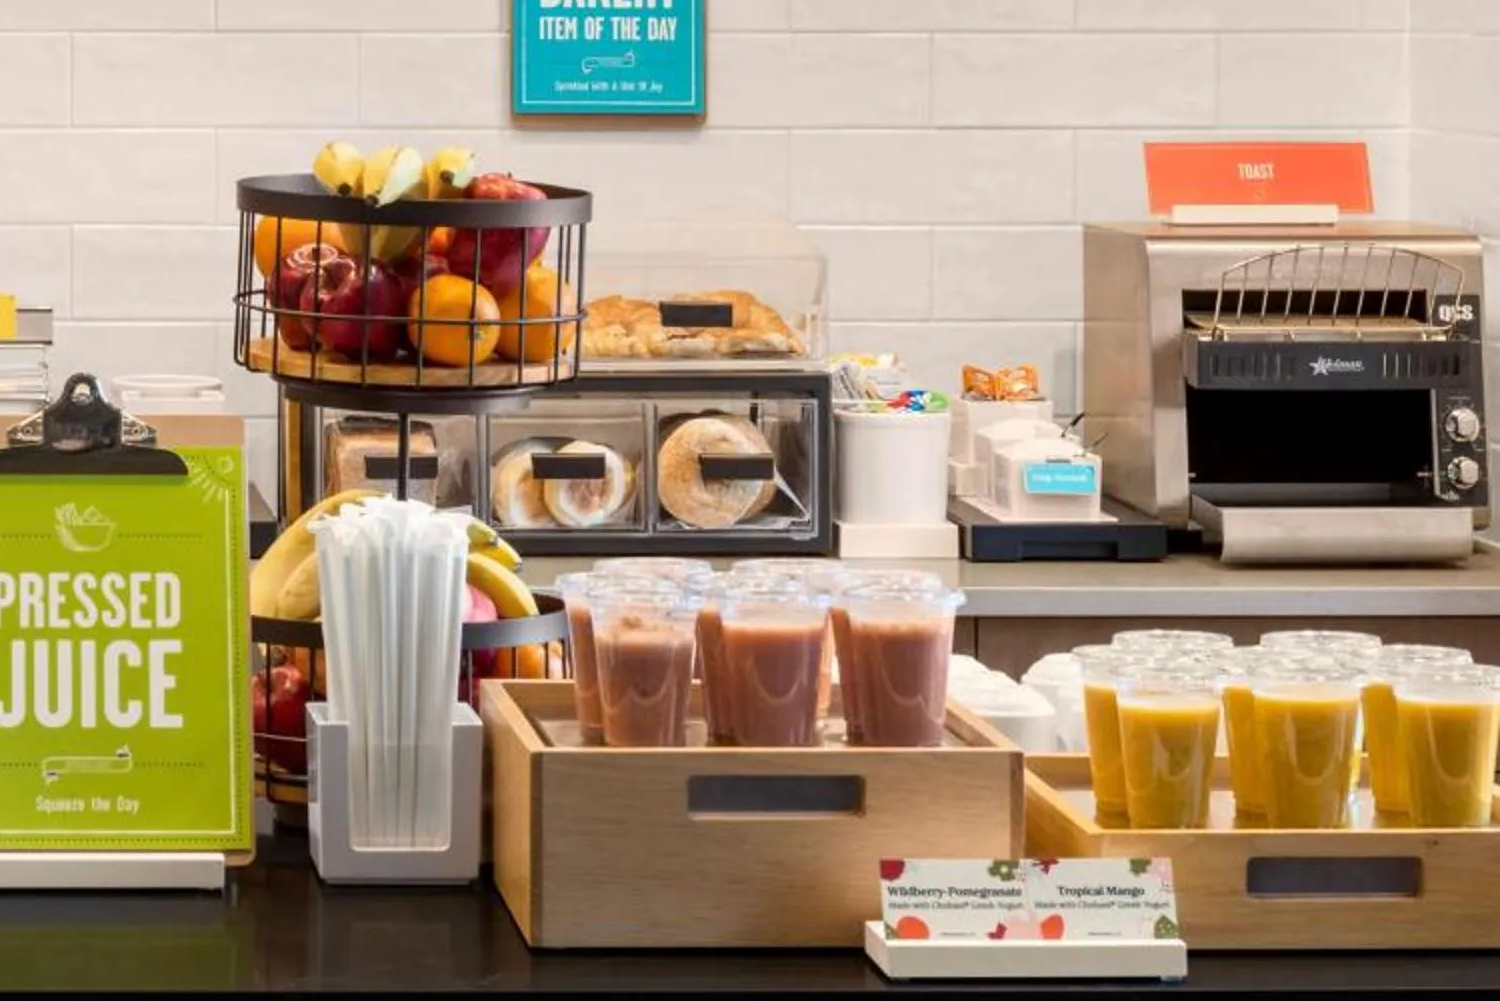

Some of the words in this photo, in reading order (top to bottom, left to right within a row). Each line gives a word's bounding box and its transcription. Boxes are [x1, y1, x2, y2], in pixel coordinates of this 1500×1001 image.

[539, 17, 577, 40] ITEM
[584, 17, 604, 40] OF
[610, 17, 641, 40] THE
[647, 17, 678, 40] DAY
[1238, 164, 1275, 179] TOAST
[36, 795, 84, 815] Squeeze
[117, 795, 139, 815] Day
[1057, 886, 1104, 898] Tropical
[1106, 886, 1146, 898] Mango
